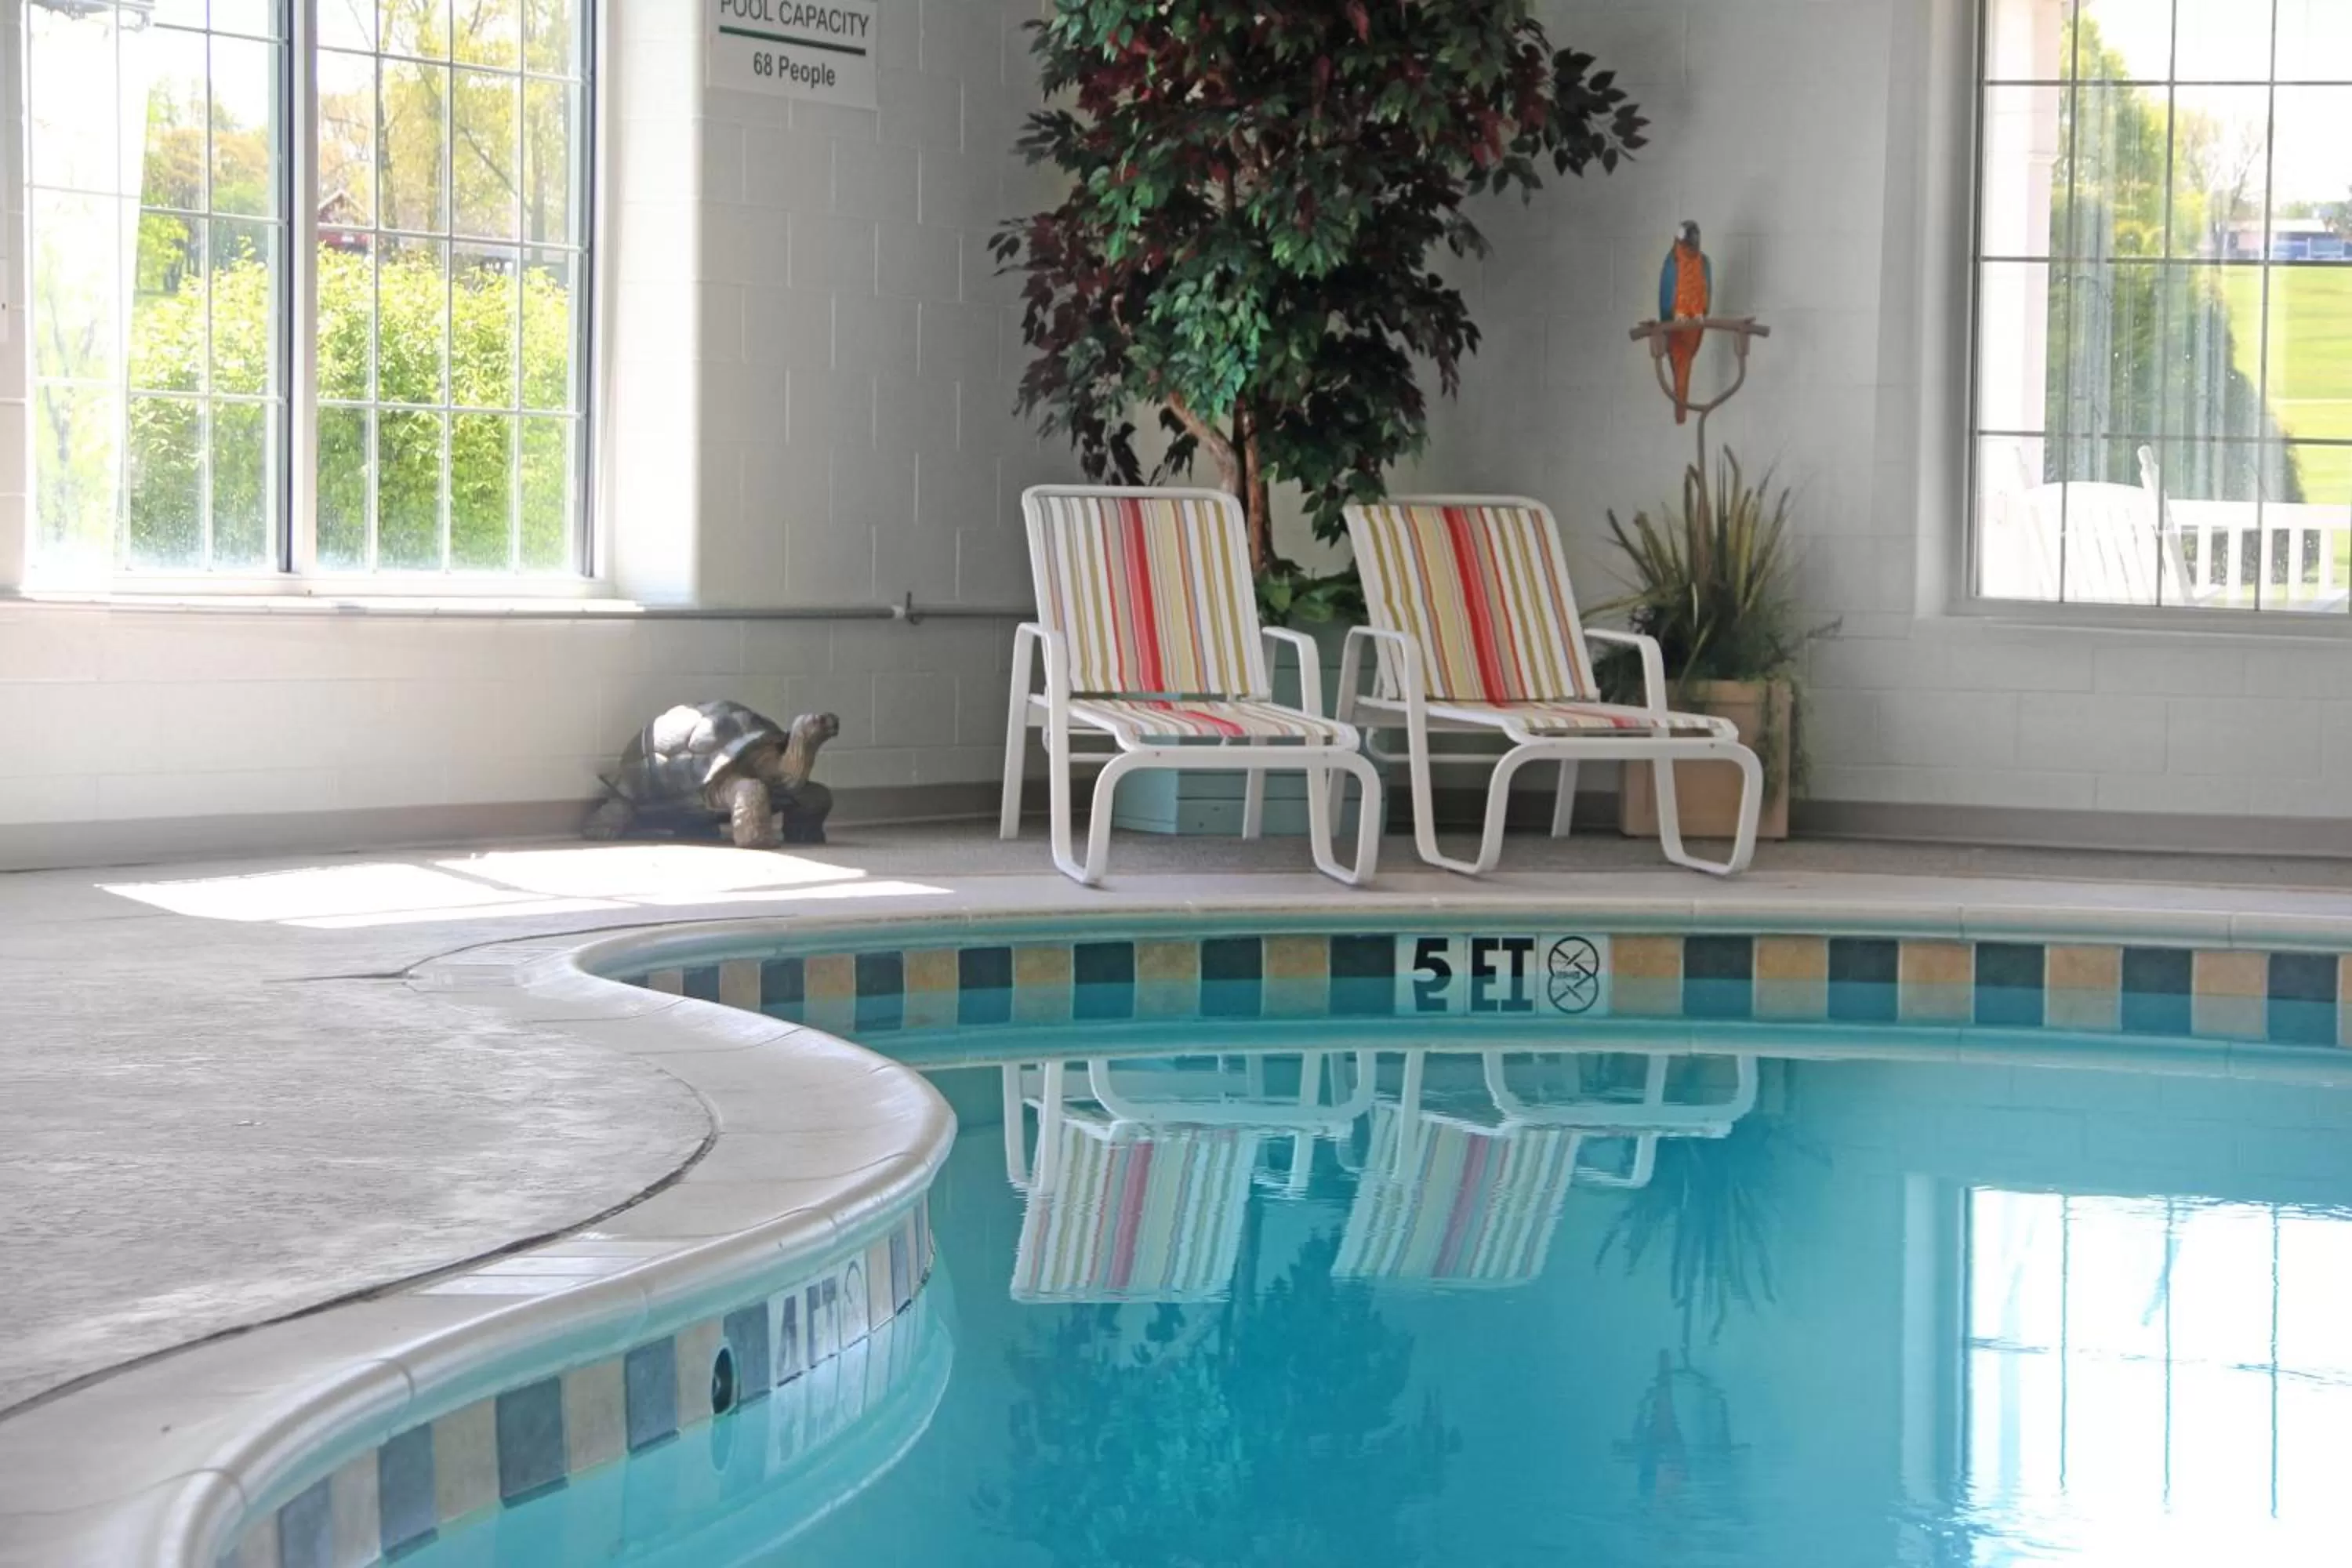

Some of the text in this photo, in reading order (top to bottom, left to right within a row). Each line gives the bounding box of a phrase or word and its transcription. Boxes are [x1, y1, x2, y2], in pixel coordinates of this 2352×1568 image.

[720, 0, 869, 38] POOL CAPACITY
[753, 52, 836, 88] 68 People
[1413, 938, 1534, 979] 5 FT
